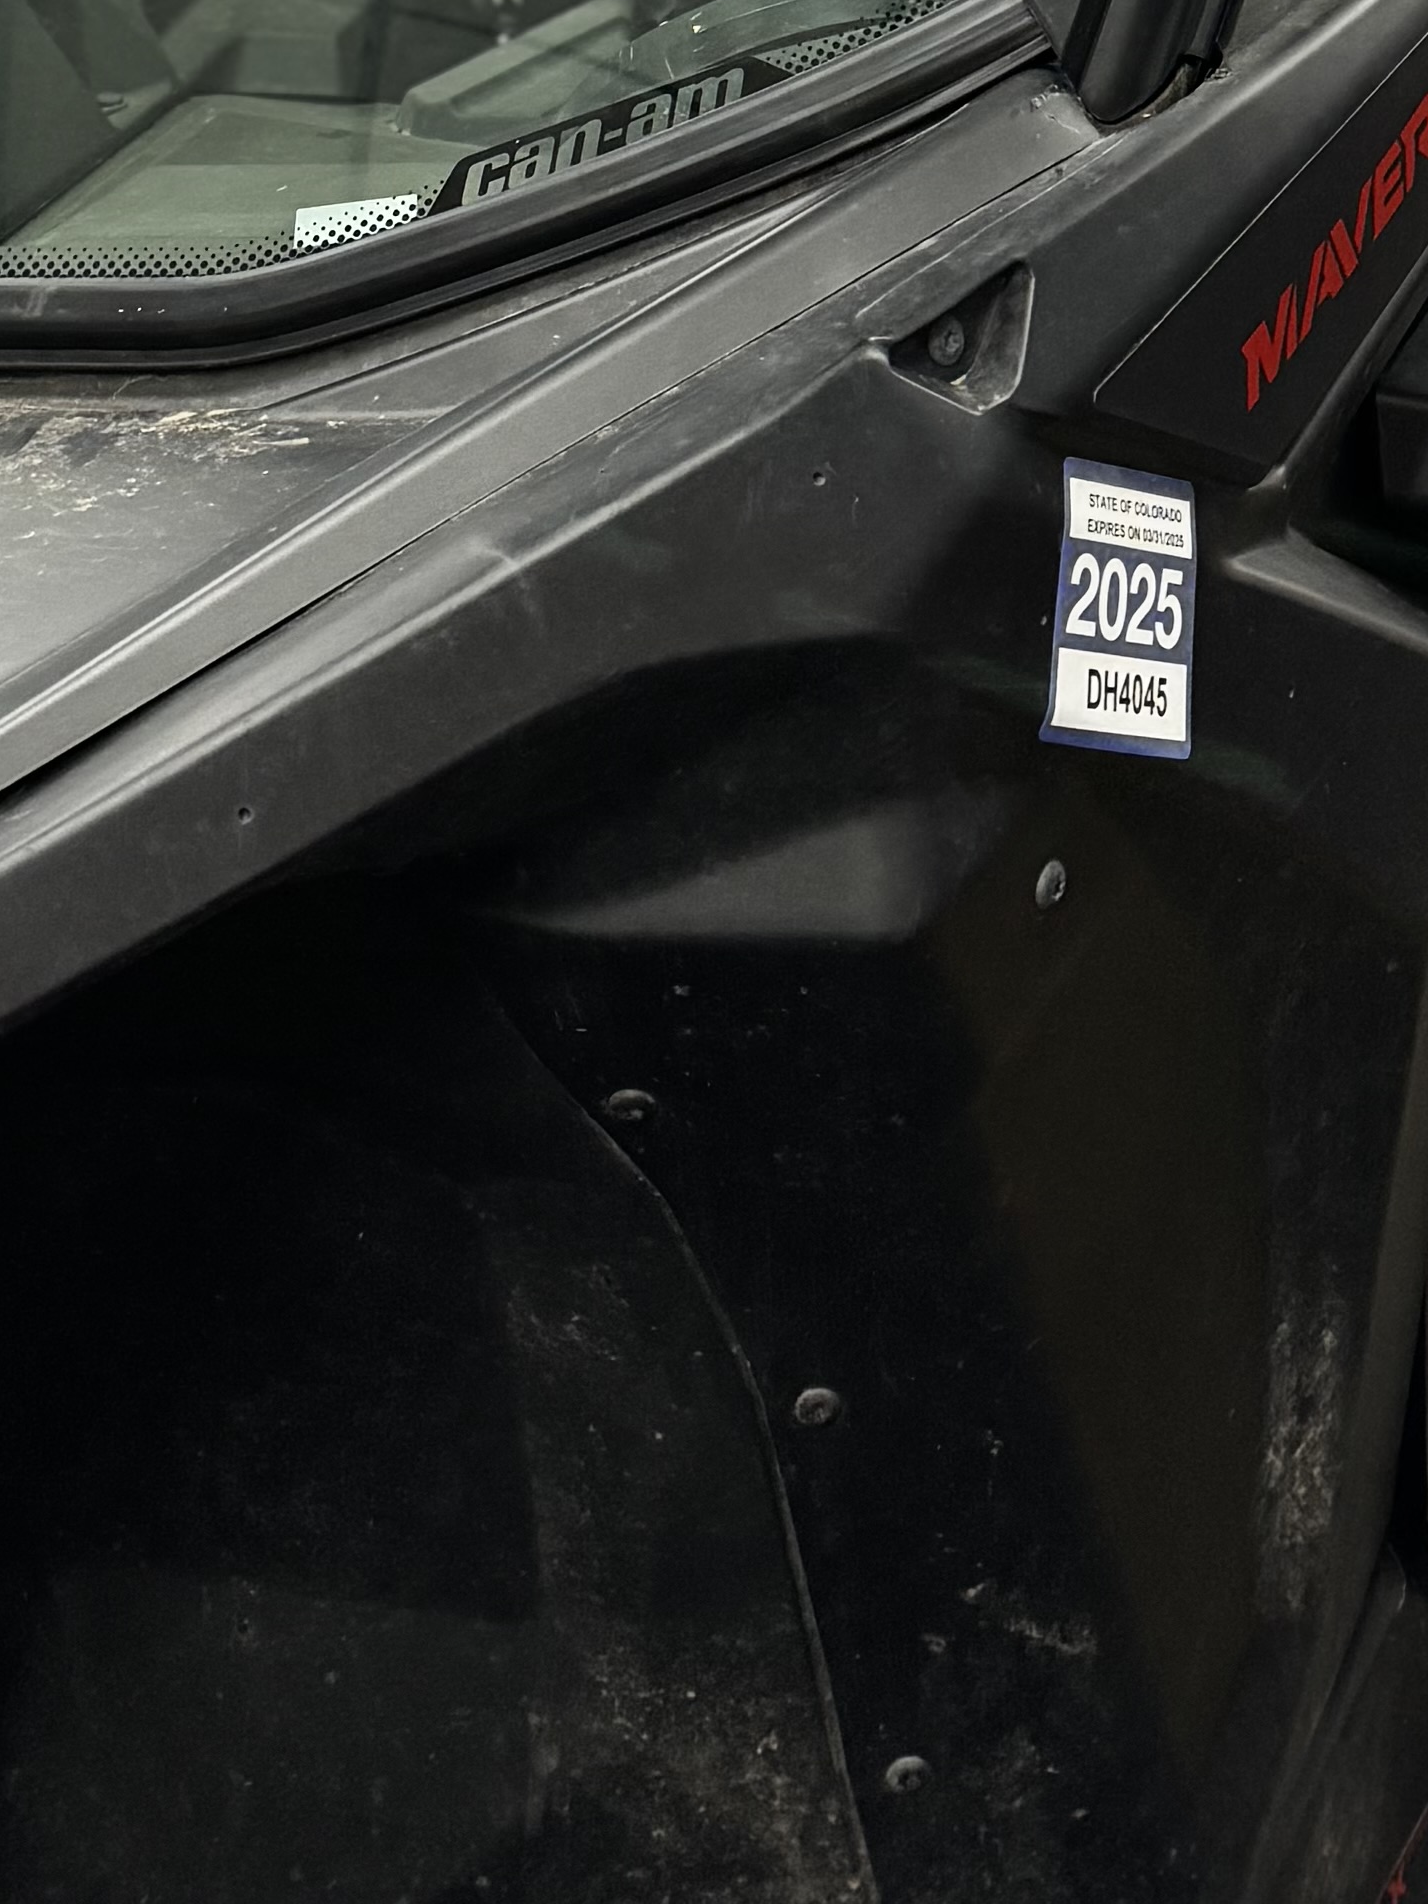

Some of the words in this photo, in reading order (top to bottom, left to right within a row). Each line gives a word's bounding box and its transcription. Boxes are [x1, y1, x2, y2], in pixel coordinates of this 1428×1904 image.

[1089, 493, 1118, 512] STATE
[1120, 499, 1132, 514] OF
[1134, 501, 1182, 523] COLORADO
[1088, 518, 1125, 538] EXPIRES
[1128, 525, 1140, 541] ON
[1143, 528, 1184, 548] 03/31/2025
[1065, 553, 1183, 650] 2025
[1087, 669, 1167, 717] DH4045
